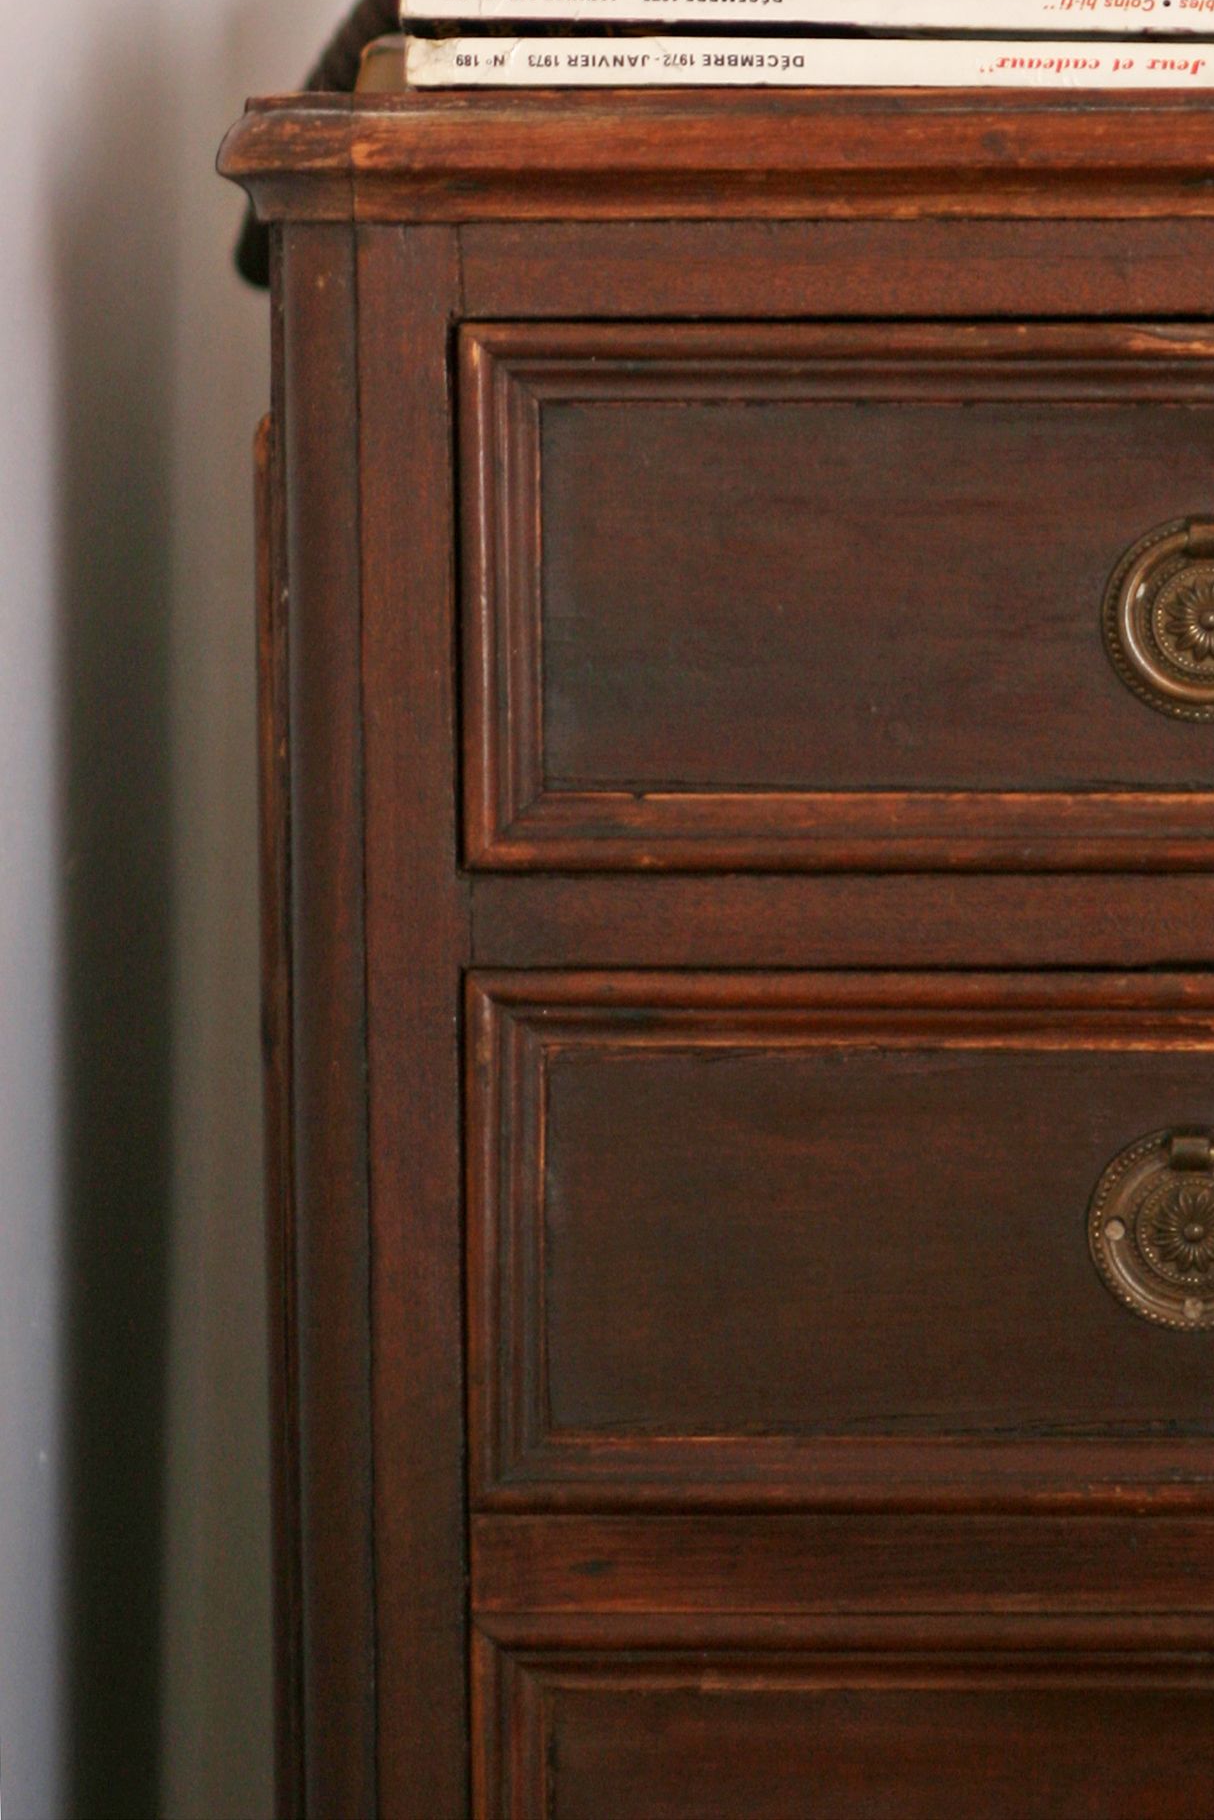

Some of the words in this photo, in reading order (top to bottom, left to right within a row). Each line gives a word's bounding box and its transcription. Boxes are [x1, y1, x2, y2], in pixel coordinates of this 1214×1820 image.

[455, 54, 480, 67] 189
[527, 54, 559, 67] 1973
[567, 54, 651, 67] JANVIER
[663, 54, 696, 67] 1972
[701, 53, 805, 70] DÉCEMBRE
[1112, 58, 1134, 72] et
[1146, 58, 1206, 75] Jeux
